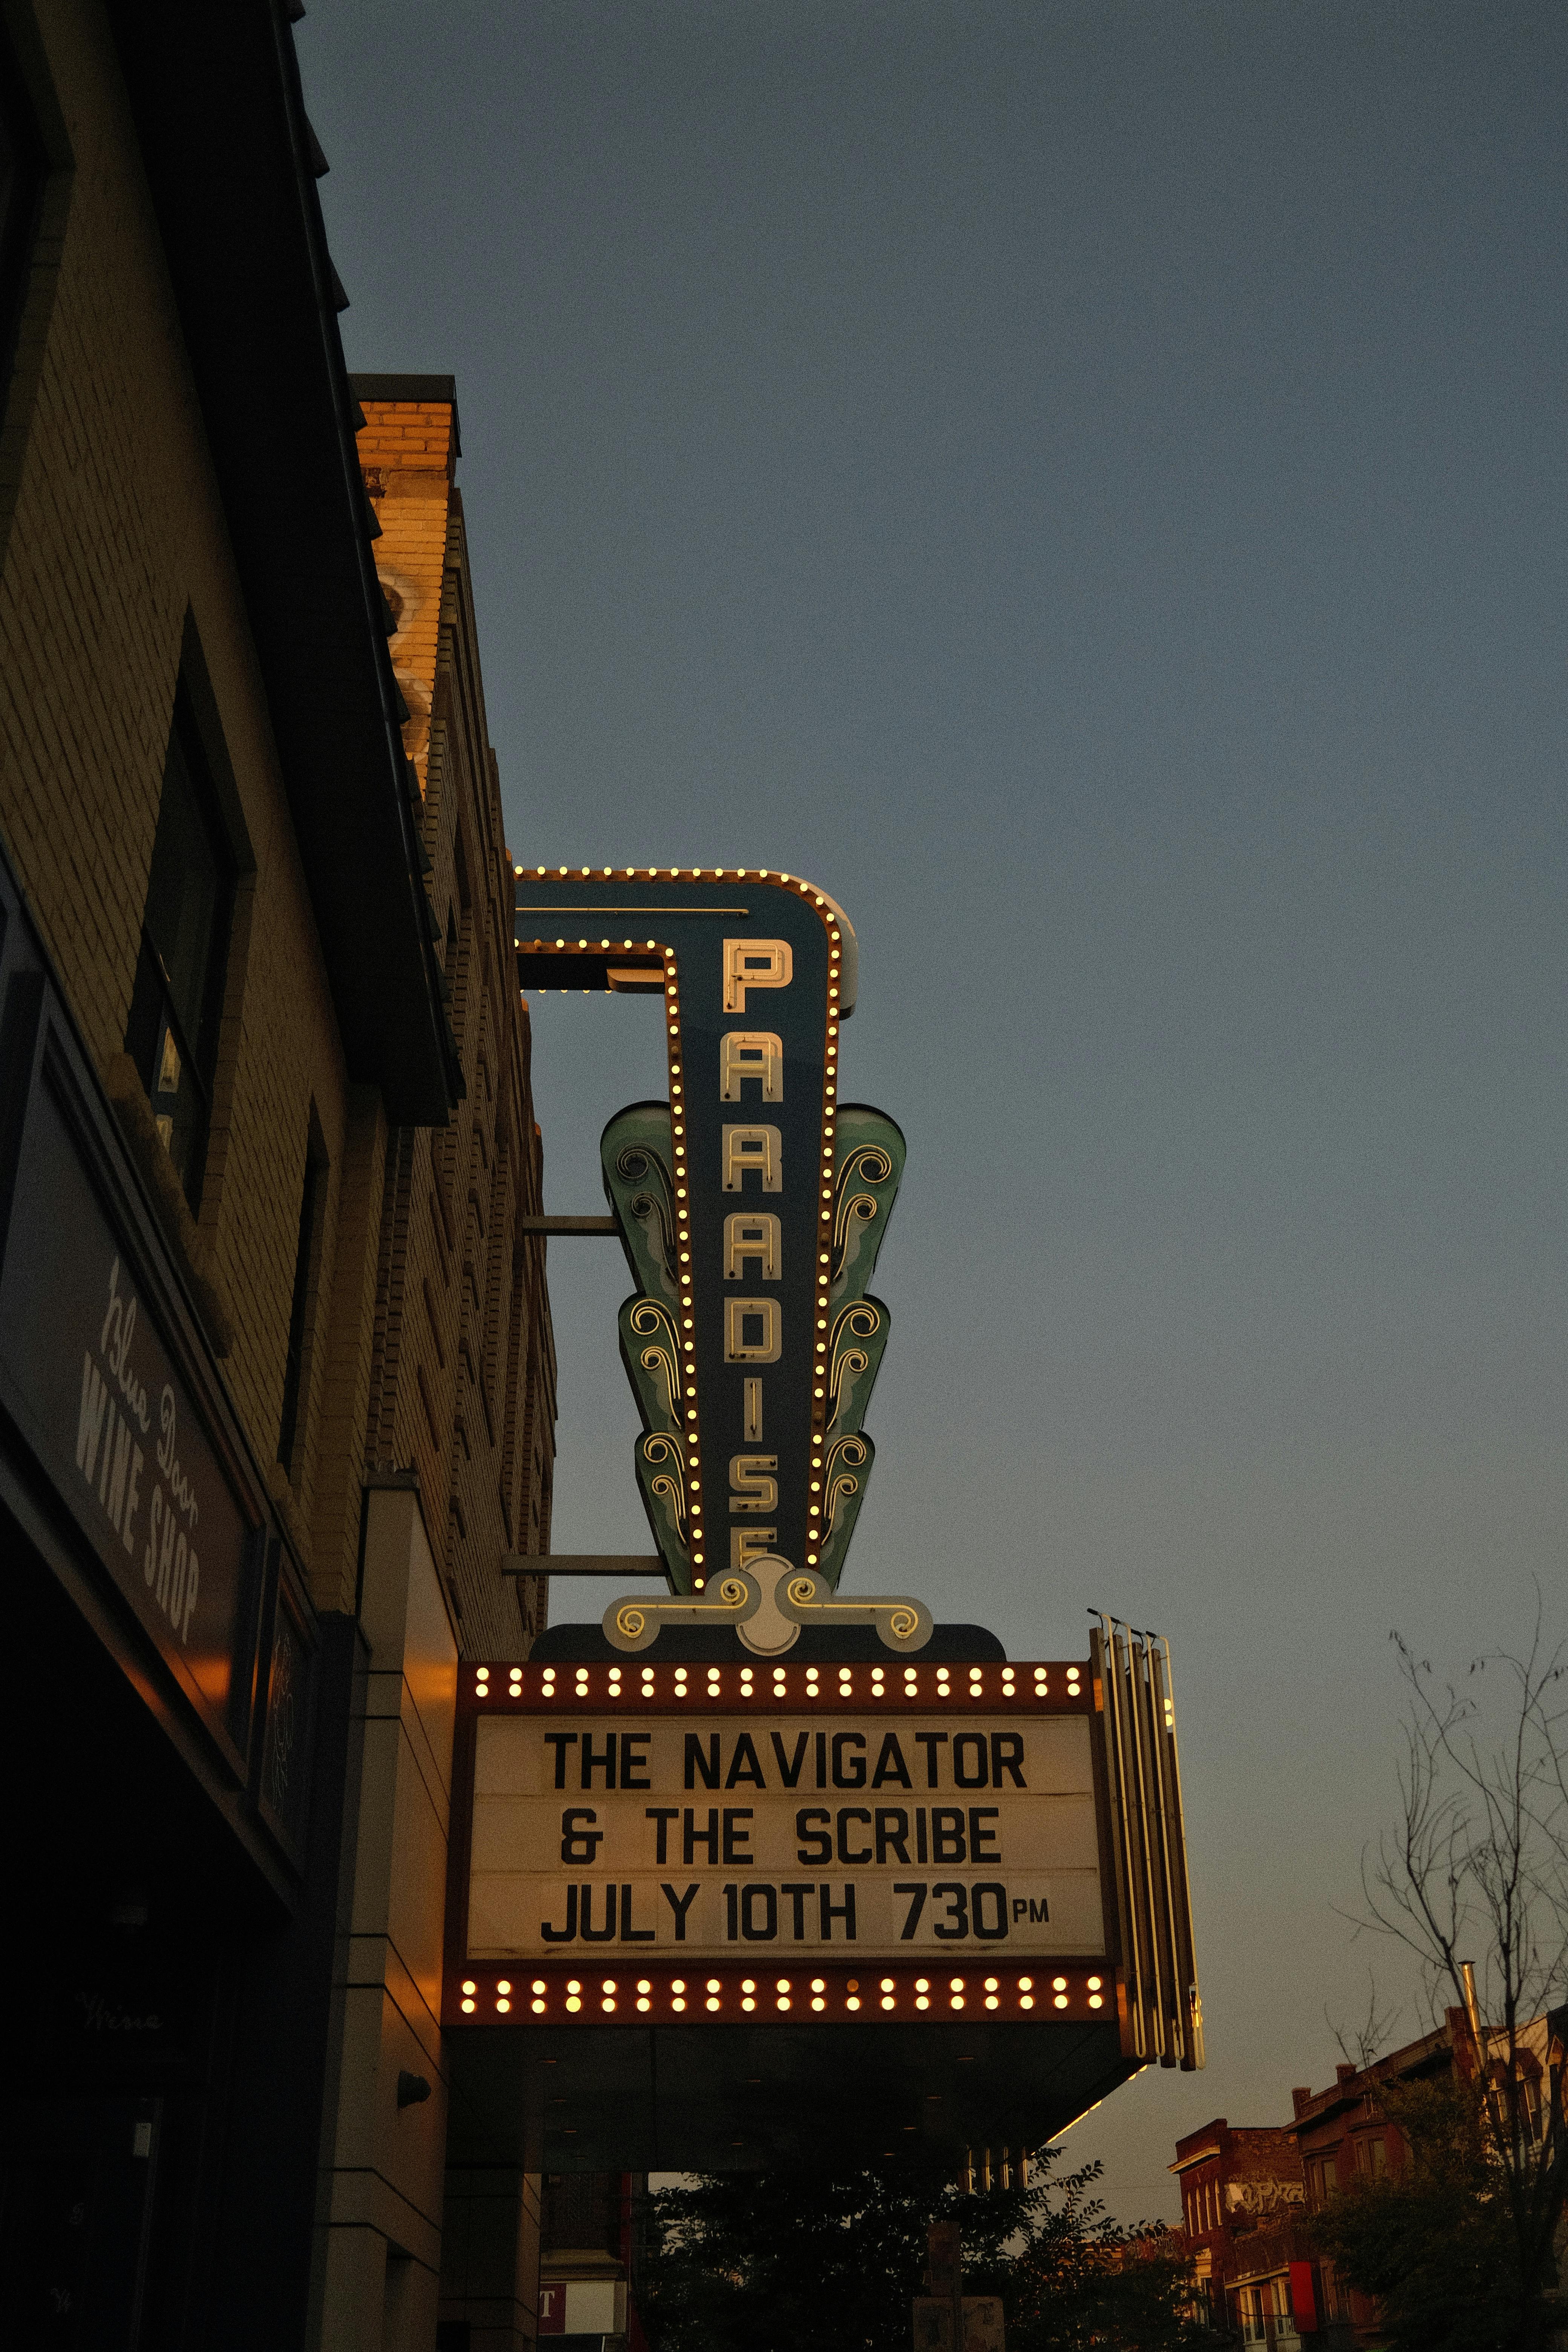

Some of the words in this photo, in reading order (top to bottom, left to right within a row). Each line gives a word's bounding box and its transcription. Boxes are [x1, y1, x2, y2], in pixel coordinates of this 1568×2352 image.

[101, 1256, 150, 1433] Blue
[156, 1383, 198, 1528] Door
[76, 1349, 145, 1556] WINE
[144, 1484, 199, 1646] SHOP
[545, 1733, 651, 1789] THE
[684, 1732, 1026, 1789] NAVIGATOR
[561, 1808, 603, 1864] &
[646, 1808, 753, 1865] THE
[796, 1808, 1001, 1865] SCRIBE
[541, 1884, 700, 1942] JULY
[723, 1884, 856, 1940] 10TH
